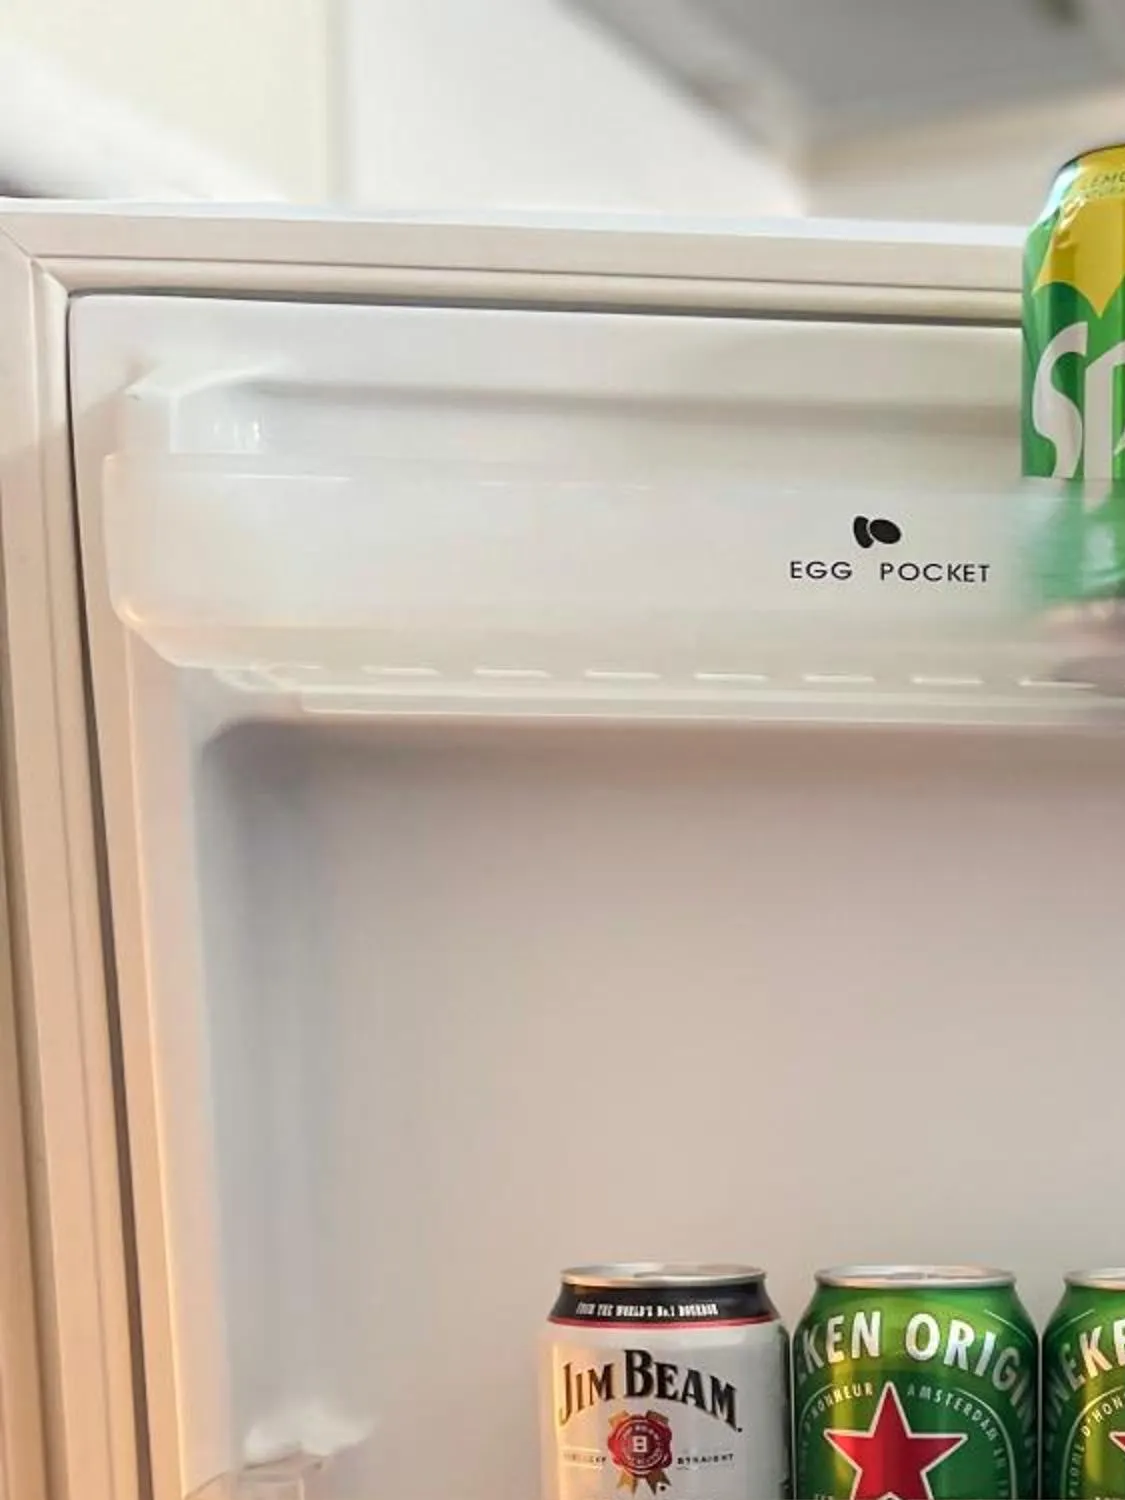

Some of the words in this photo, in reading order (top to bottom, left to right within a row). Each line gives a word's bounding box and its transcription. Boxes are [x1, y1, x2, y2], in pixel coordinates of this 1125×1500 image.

[789, 561, 853, 580] EGG
[880, 562, 990, 582] POCKET
[558, 1361, 615, 1427] JIM
[622, 1348, 739, 1430] BEAM
[906, 1382, 1001, 1443] AMSTERDAM
